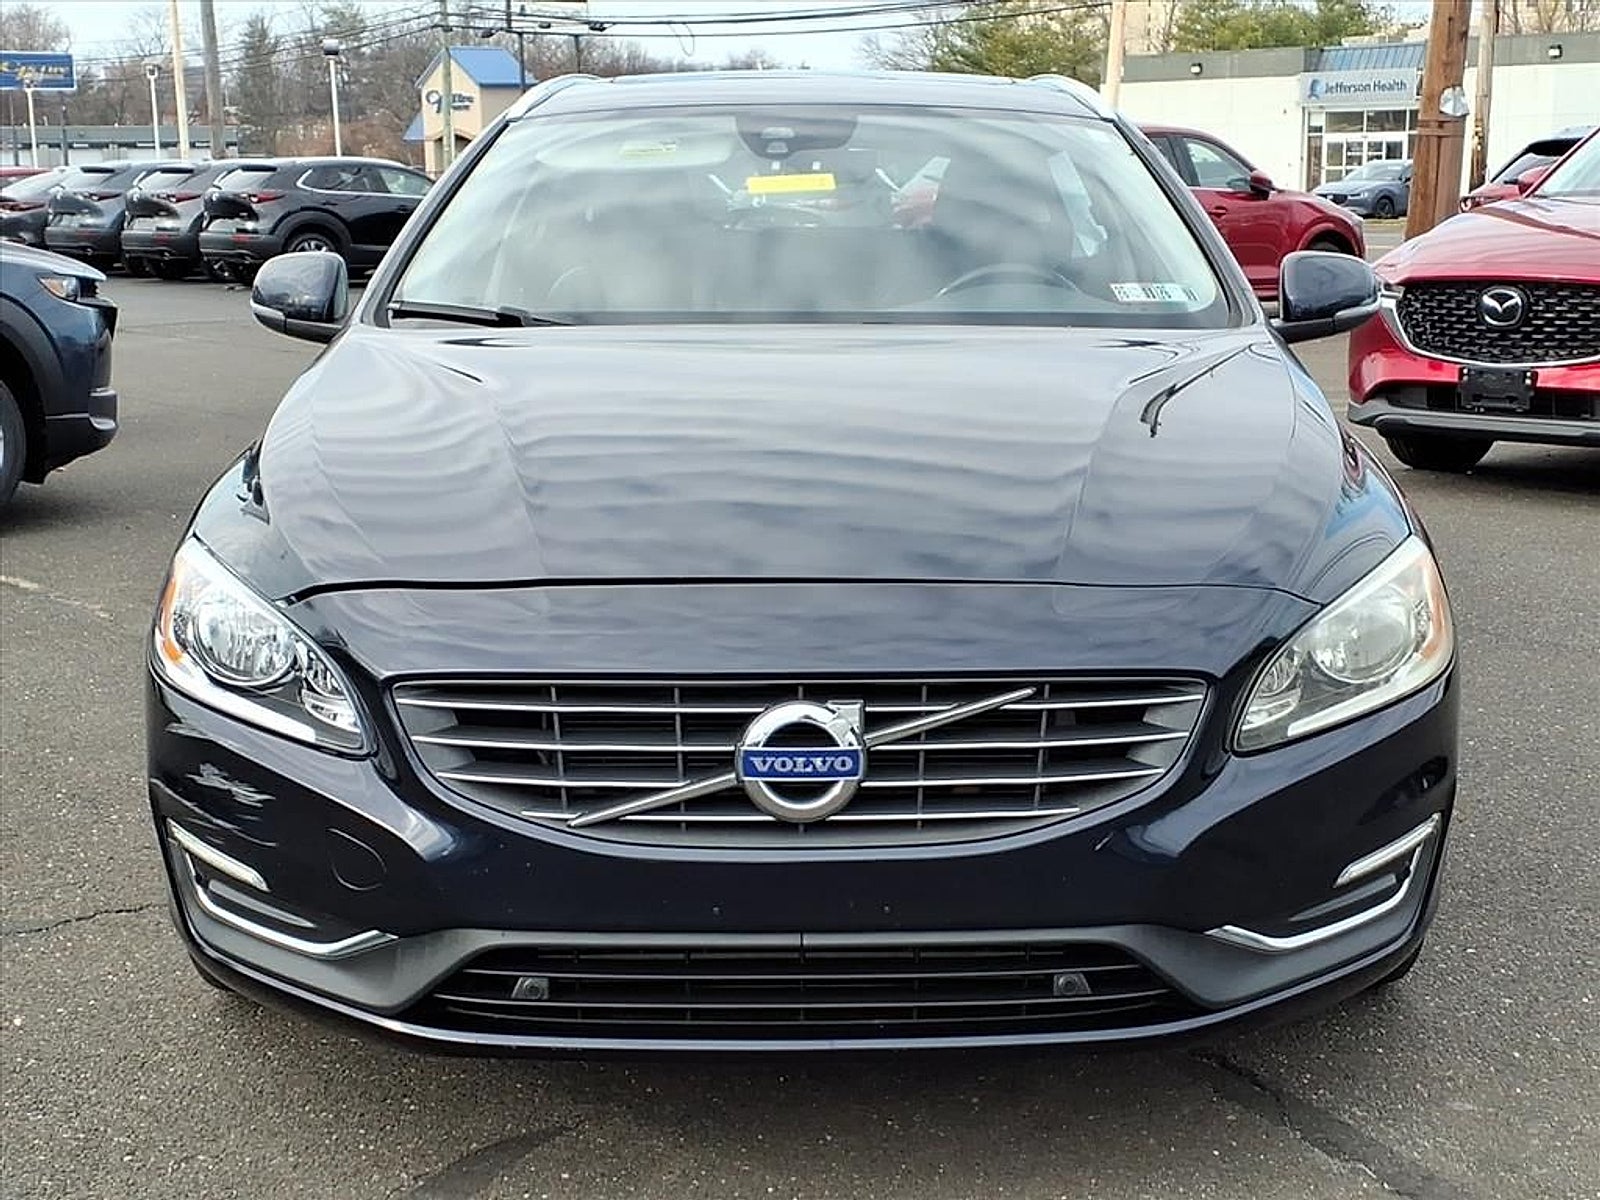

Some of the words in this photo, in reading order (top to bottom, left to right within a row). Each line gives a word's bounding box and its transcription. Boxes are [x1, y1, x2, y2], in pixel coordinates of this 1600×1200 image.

[1324, 82, 1371, 94] Jefferson
[1373, 79, 1407, 93] Health
[749, 755, 853, 773] VOLVO
